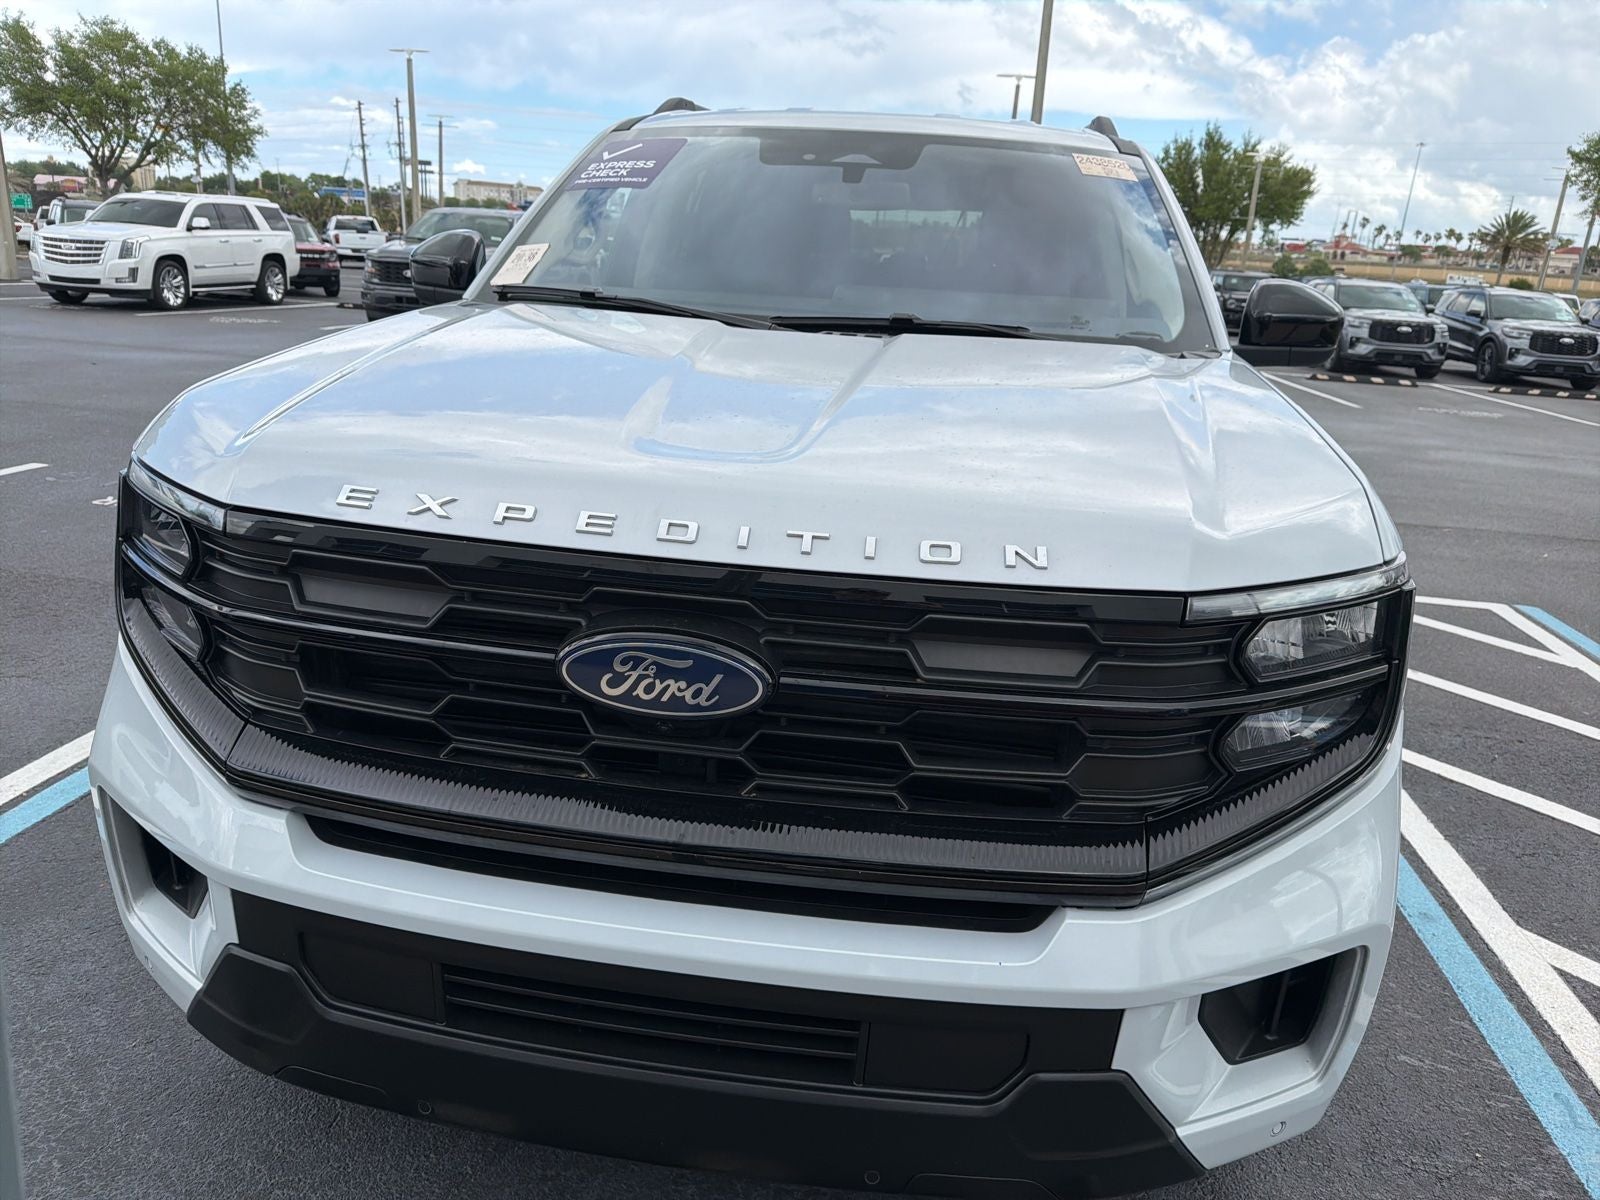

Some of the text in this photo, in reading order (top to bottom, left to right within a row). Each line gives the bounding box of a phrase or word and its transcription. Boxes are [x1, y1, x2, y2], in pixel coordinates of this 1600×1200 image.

[580, 168, 631, 178] CHECK
[588, 160, 657, 170] EXPRESS
[335, 483, 1049, 570] EXPEDITION
[599, 651, 725, 707] Ford
